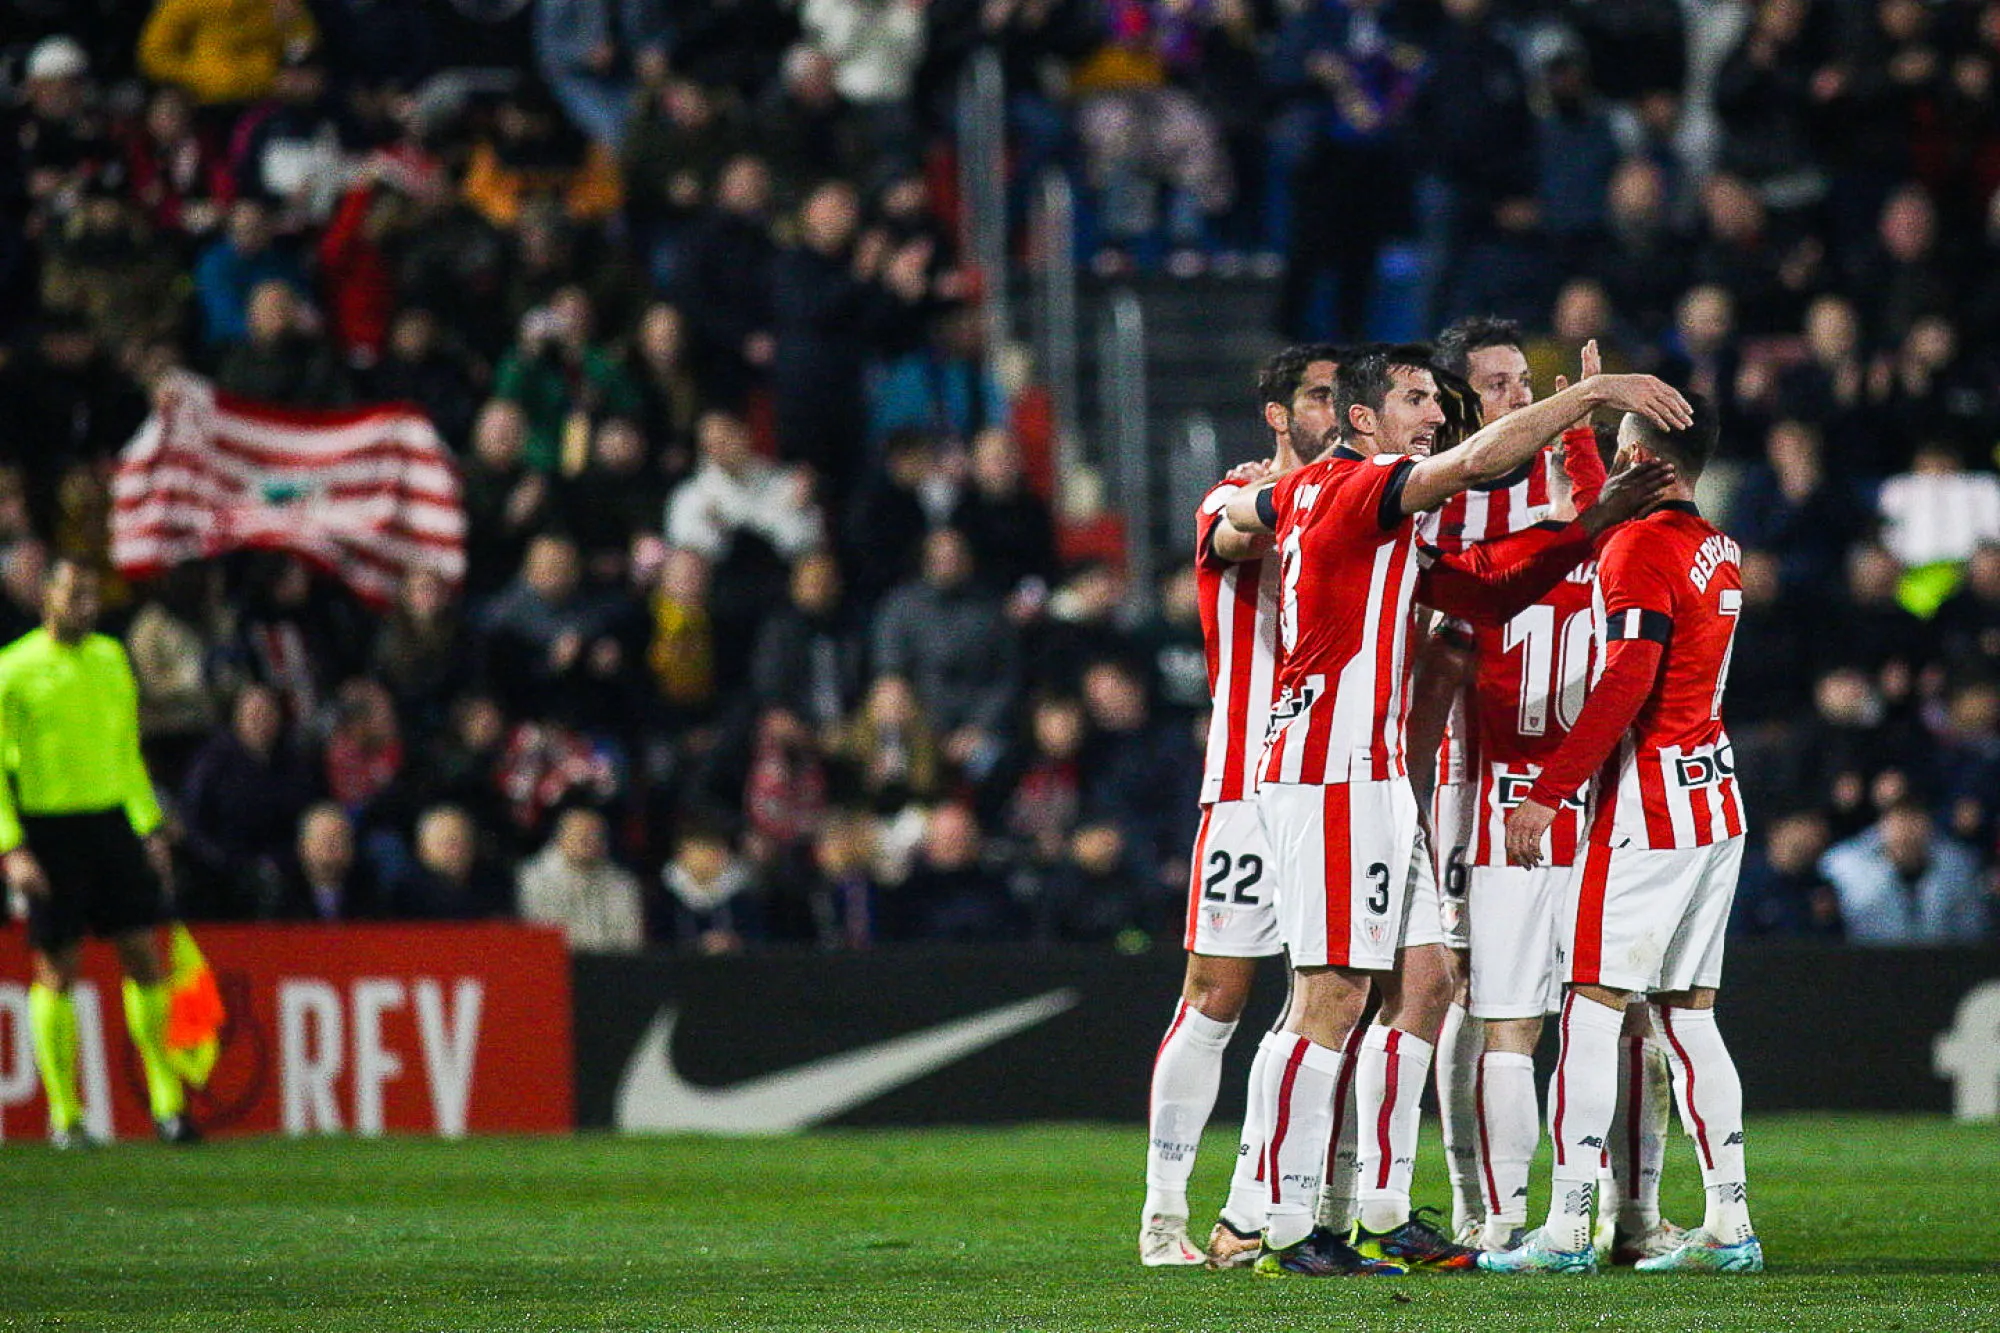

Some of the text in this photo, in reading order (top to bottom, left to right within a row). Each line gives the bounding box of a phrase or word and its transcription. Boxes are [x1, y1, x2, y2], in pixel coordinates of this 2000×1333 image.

[1204, 849, 1263, 905] 22
[1366, 861, 1390, 916] 3
[1445, 845, 1467, 898] 6
